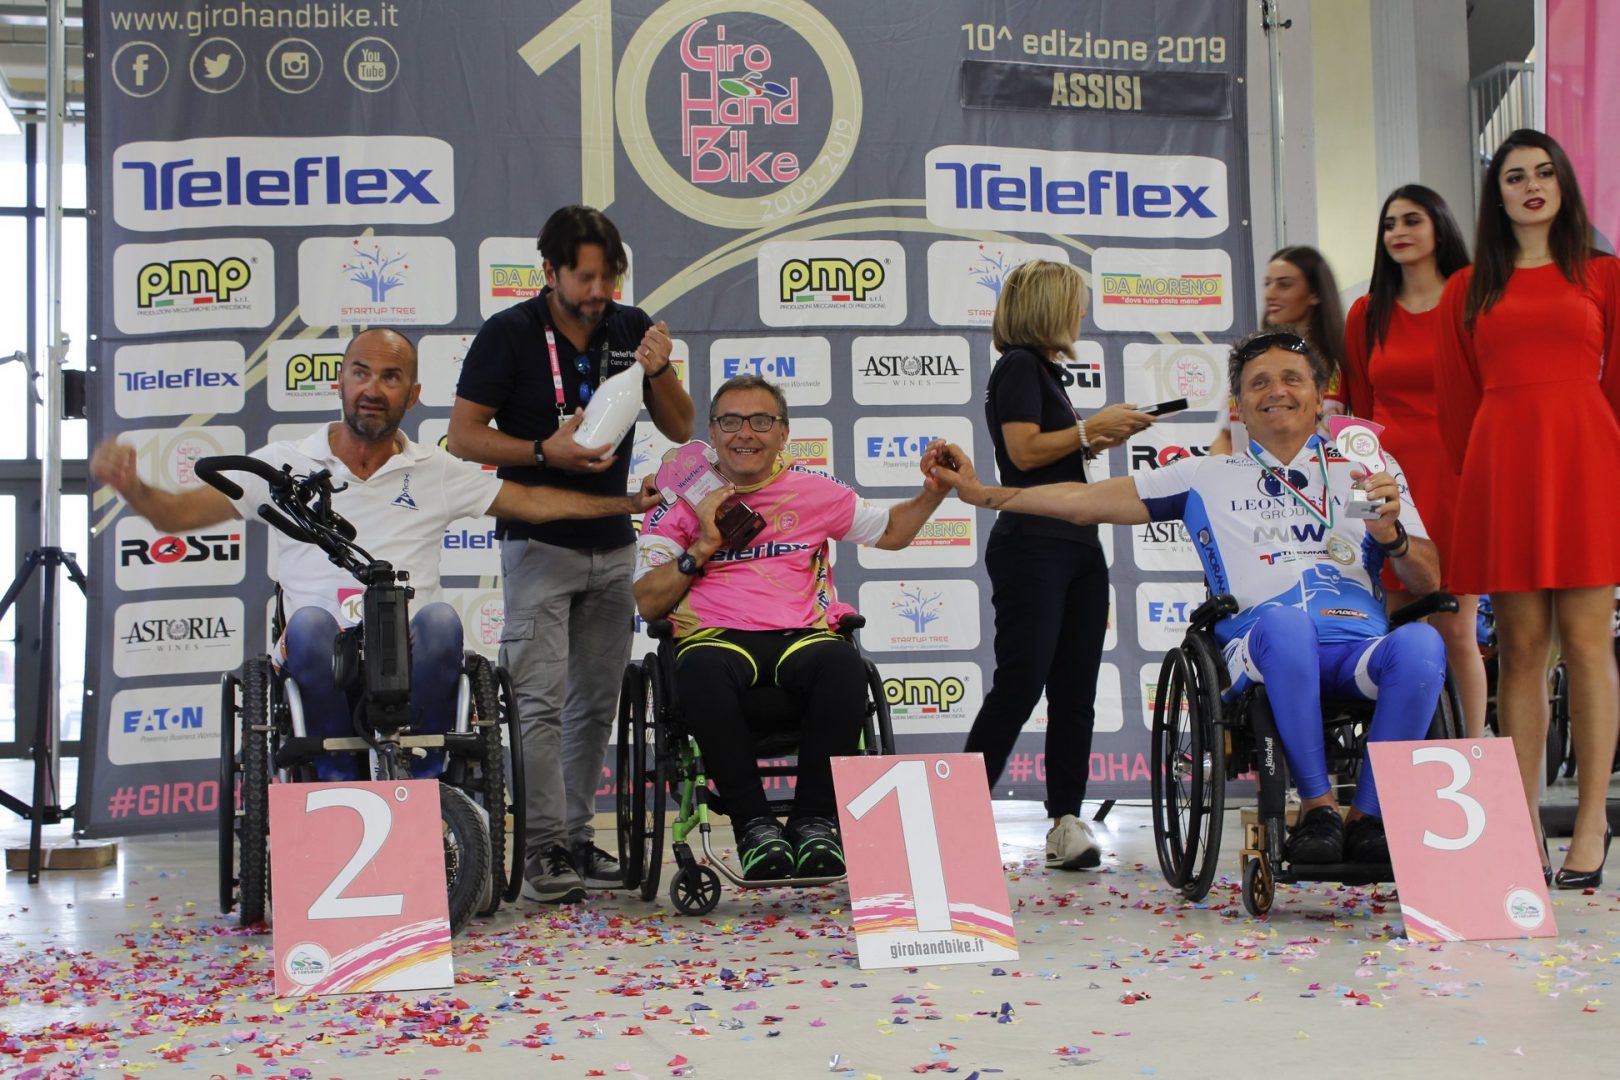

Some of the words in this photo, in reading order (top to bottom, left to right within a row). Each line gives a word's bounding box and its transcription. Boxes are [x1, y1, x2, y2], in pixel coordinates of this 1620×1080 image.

[111, 3, 399, 36] www.girohandbike.it
[361, 48, 381, 62] You
[680, 19, 772, 72] Giro
[1022, 29, 1148, 62] edizione
[1157, 36, 1227, 64] 2019
[360, 64, 385, 79] Tube
[1050, 72, 1142, 111] ASSISI
[517, 0, 863, 229] 10
[681, 73, 799, 156] Hand
[690, 126, 800, 183] Bike
[122, 156, 441, 211] Teleflex
[759, 118, 854, 221] 2009-2019
[935, 162, 1218, 219] Teleflex
[137, 256, 251, 308] pmp
[492, 268, 523, 287] DA
[780, 257, 885, 302] pmp
[1103, 277, 1130, 294] DA
[1136, 278, 1218, 295] MORENO
[341, 307, 388, 315] STARTUP
[390, 306, 416, 315] TREE
[967, 309, 995, 317] STAR
[118, 368, 240, 392] Teleflex
[286, 353, 345, 391] pm
[858, 355, 965, 377] ASTORIA
[1340, 431, 1378, 457] 10
[917, 522, 967, 537] RENO
[120, 616, 237, 644] ASTORIA
[156, 644, 200, 652] WINES
[123, 706, 204, 733] EATON
[890, 938, 985, 959] girohandbike.it
